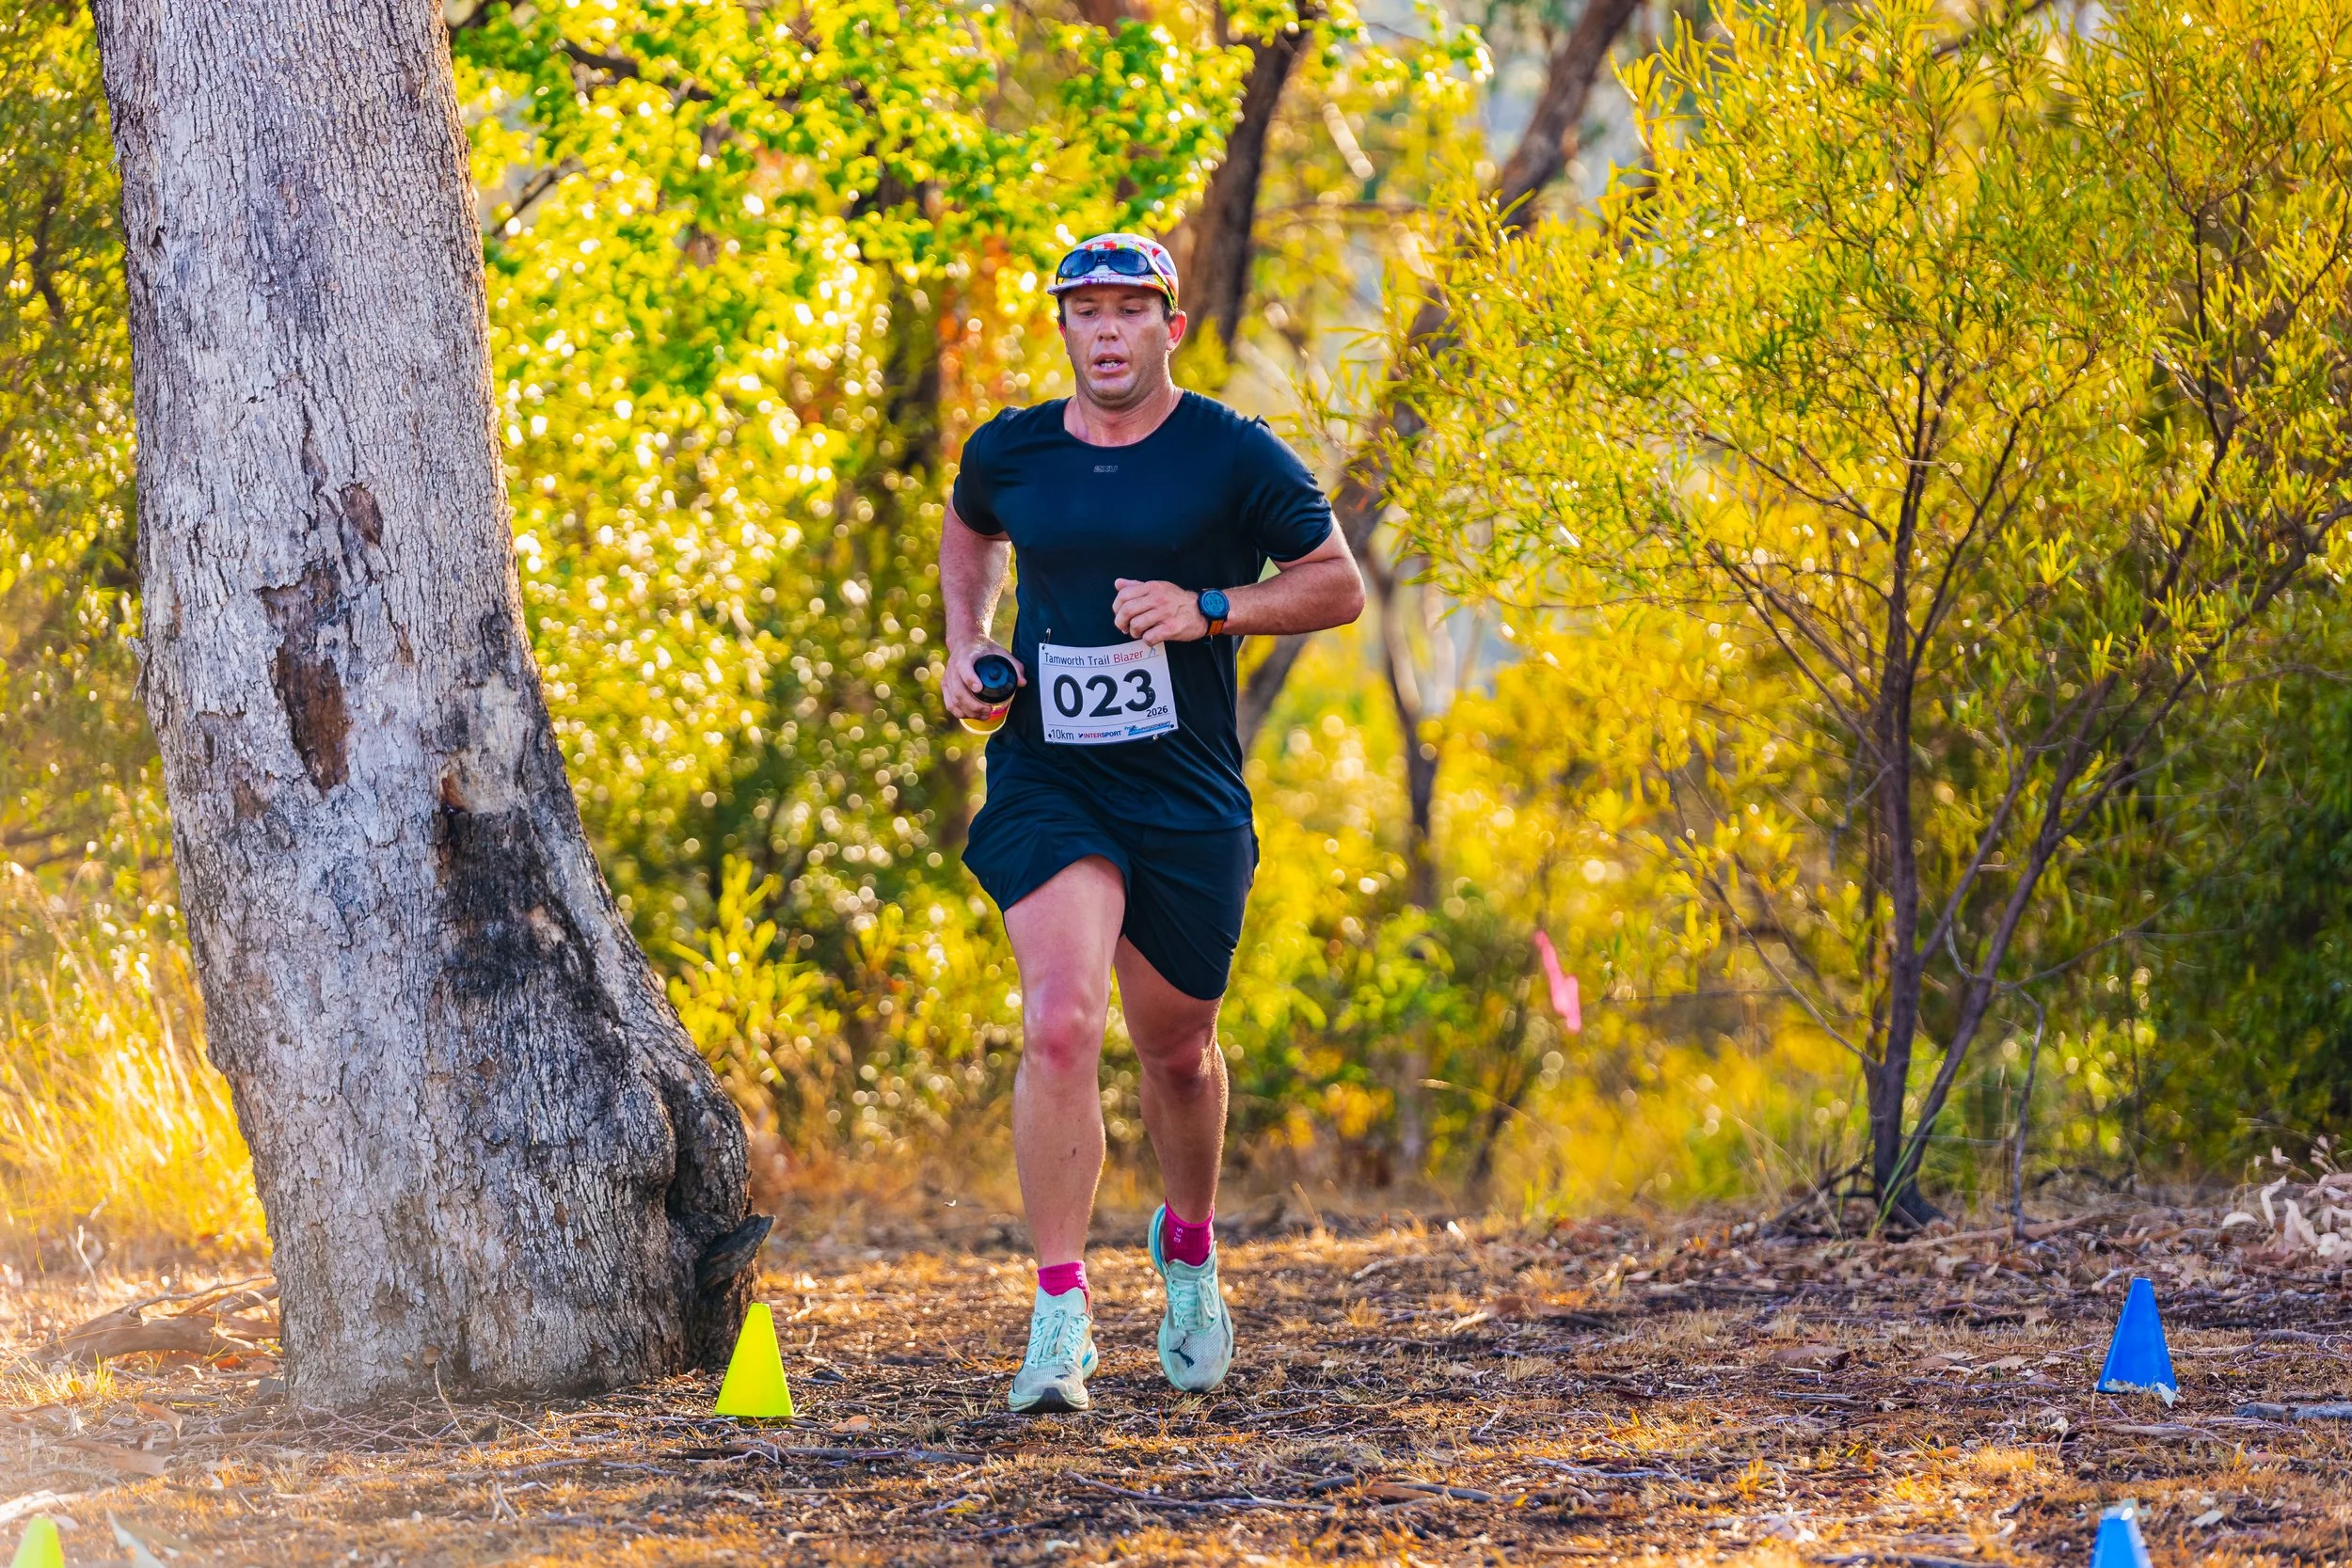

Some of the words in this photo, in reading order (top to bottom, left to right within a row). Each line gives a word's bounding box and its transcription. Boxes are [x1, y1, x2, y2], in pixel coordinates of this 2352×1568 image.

[1044, 652, 1085, 666] Tamworth
[1088, 655, 1110, 666] Trail
[1113, 650, 1144, 663] Blazer
[1053, 668, 1156, 718] 023
[1146, 705, 1168, 718] 2026
[1050, 728, 1074, 739] 10km
[1083, 730, 1121, 738] INTERSPORT
